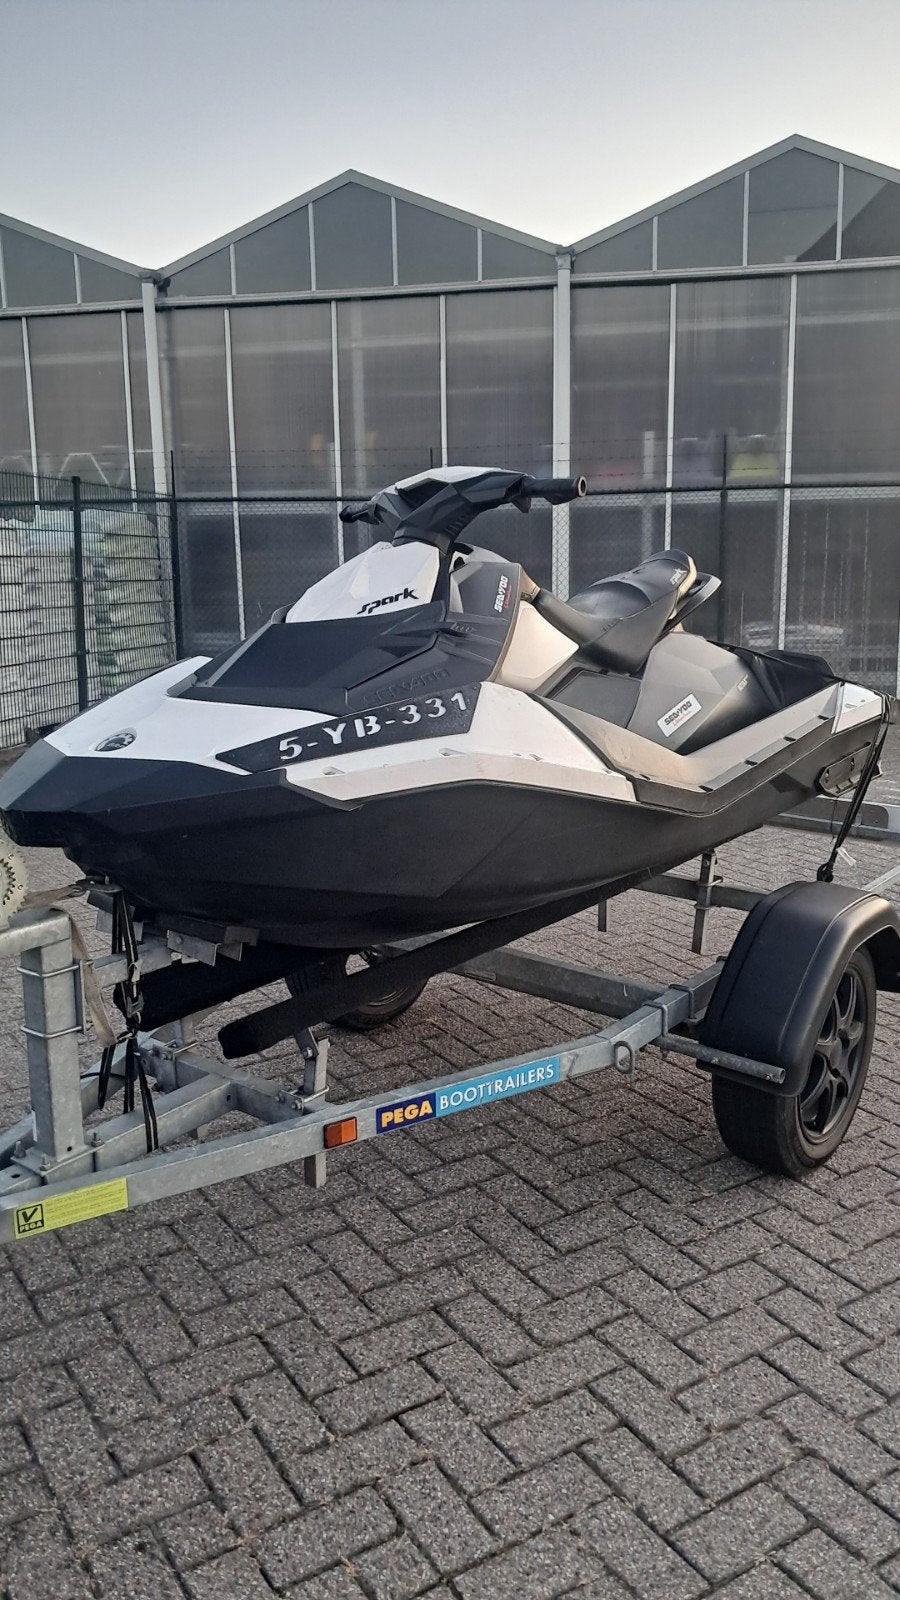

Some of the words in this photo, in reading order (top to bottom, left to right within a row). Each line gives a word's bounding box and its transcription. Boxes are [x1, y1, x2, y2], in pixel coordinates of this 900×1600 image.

[279, 692, 468, 760] 5-YB-331
[381, 1100, 434, 1129] PEGA
[440, 1064, 554, 1110] BOOTTRAILERS
